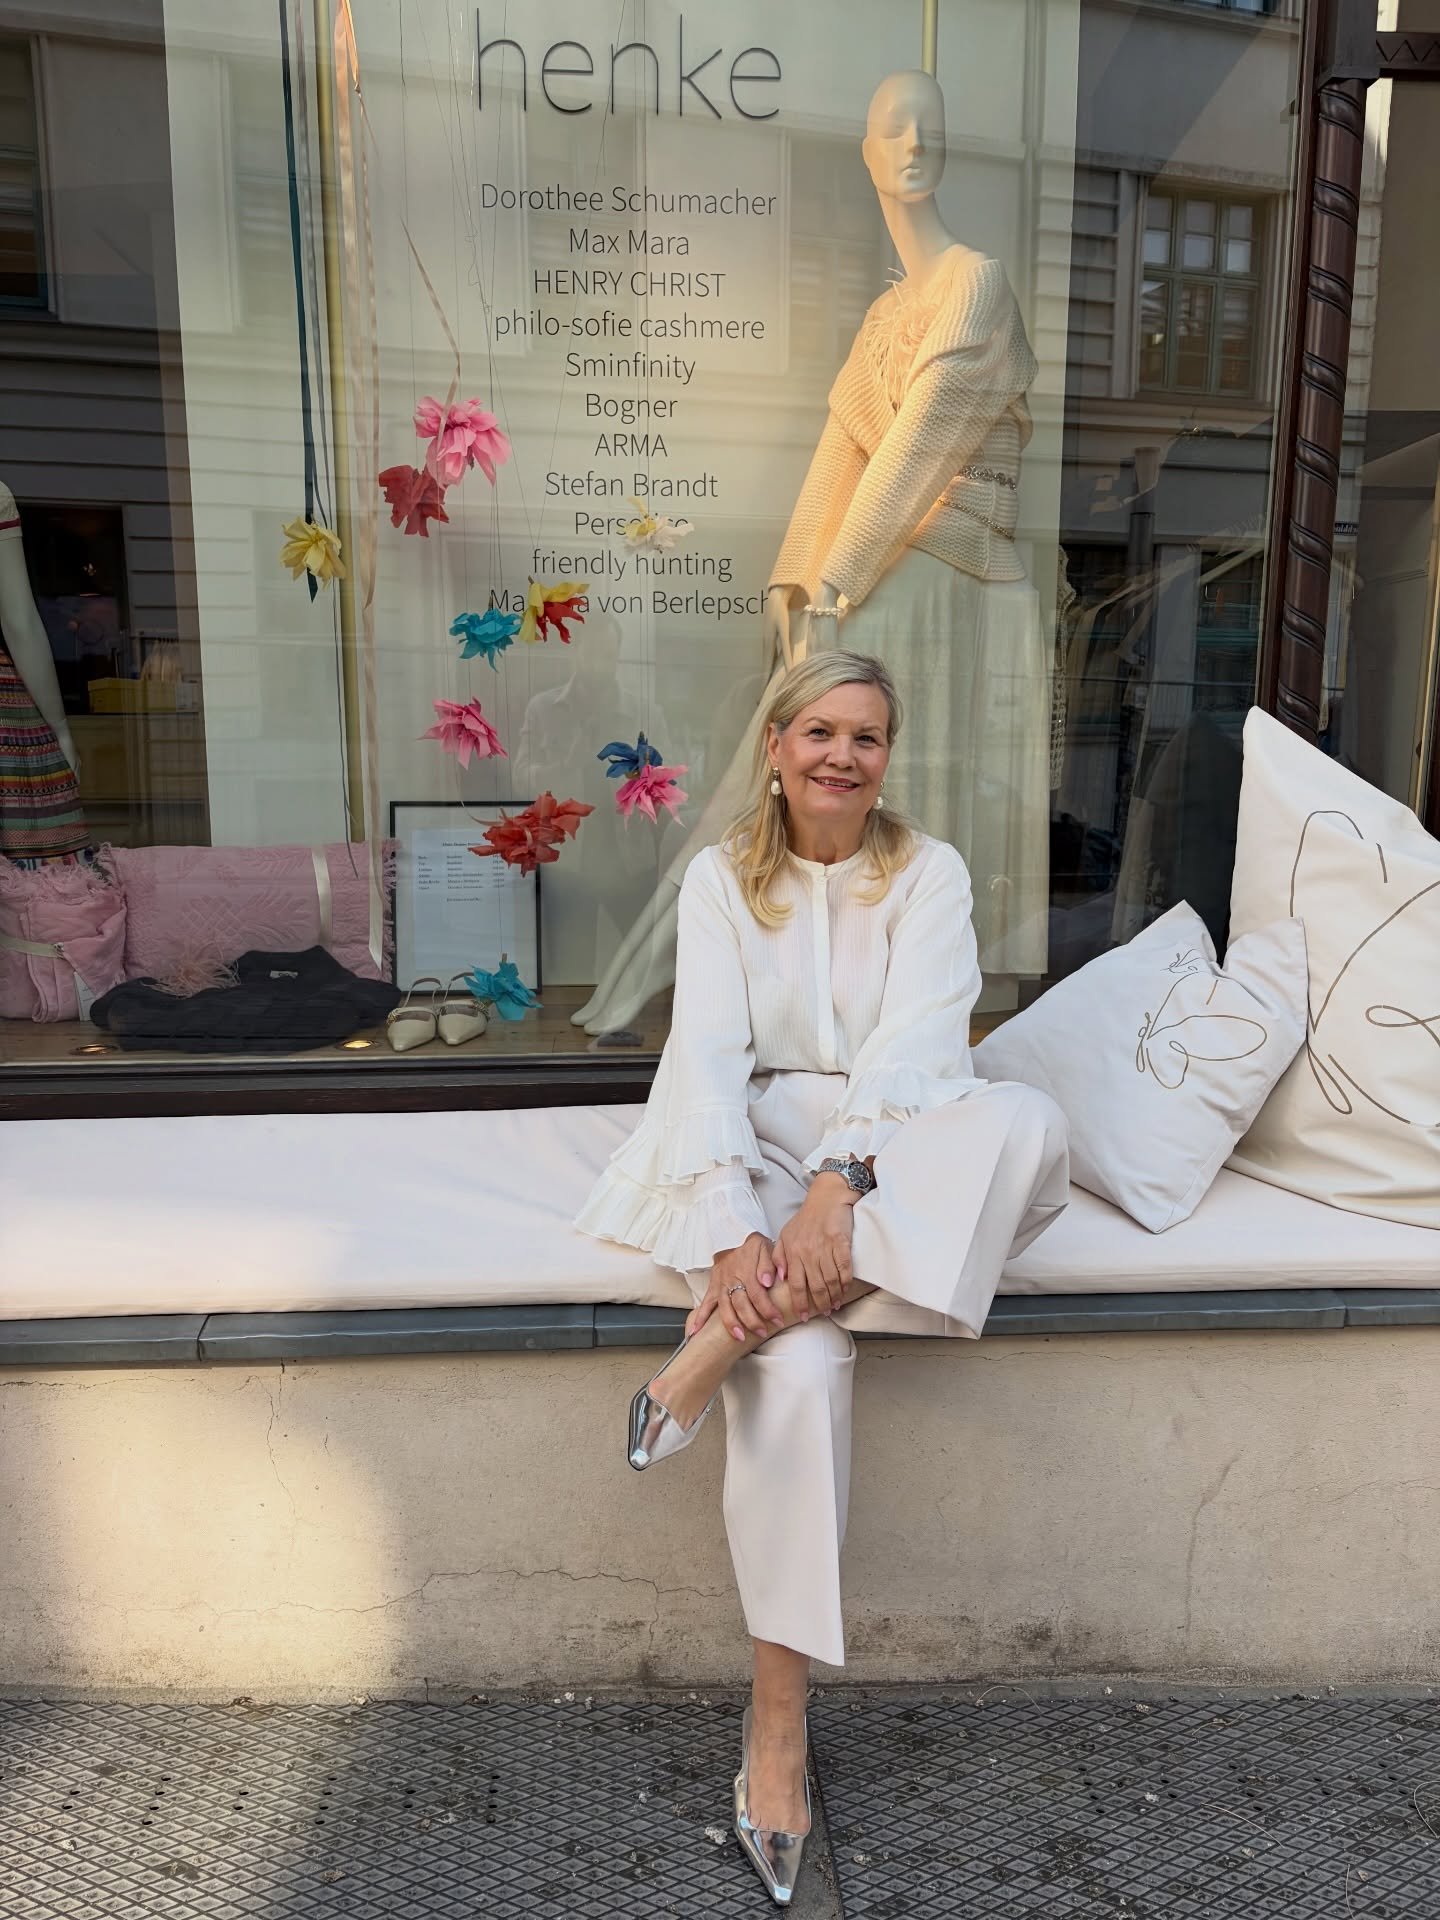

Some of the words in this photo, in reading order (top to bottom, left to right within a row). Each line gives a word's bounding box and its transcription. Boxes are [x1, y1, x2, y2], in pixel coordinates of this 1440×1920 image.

[476, 7, 782, 120] henke
[481, 183, 604, 212] Dorothee
[611, 185, 777, 215] Schumacher
[569, 228, 620, 254] Max
[628, 229, 689, 256] Mara
[534, 270, 623, 296] HENRY
[630, 271, 726, 298] CHRIST
[495, 309, 632, 341] philo-sofie
[640, 312, 765, 339] cashmere
[565, 352, 696, 385] Sminfinity
[585, 393, 679, 425] Bogner
[594, 433, 668, 458] ARMA
[545, 471, 624, 497] Stefan
[633, 472, 719, 498] Brandt
[532, 548, 627, 582] friendly
[635, 553, 733, 583] hunting
[597, 596, 643, 614] von
